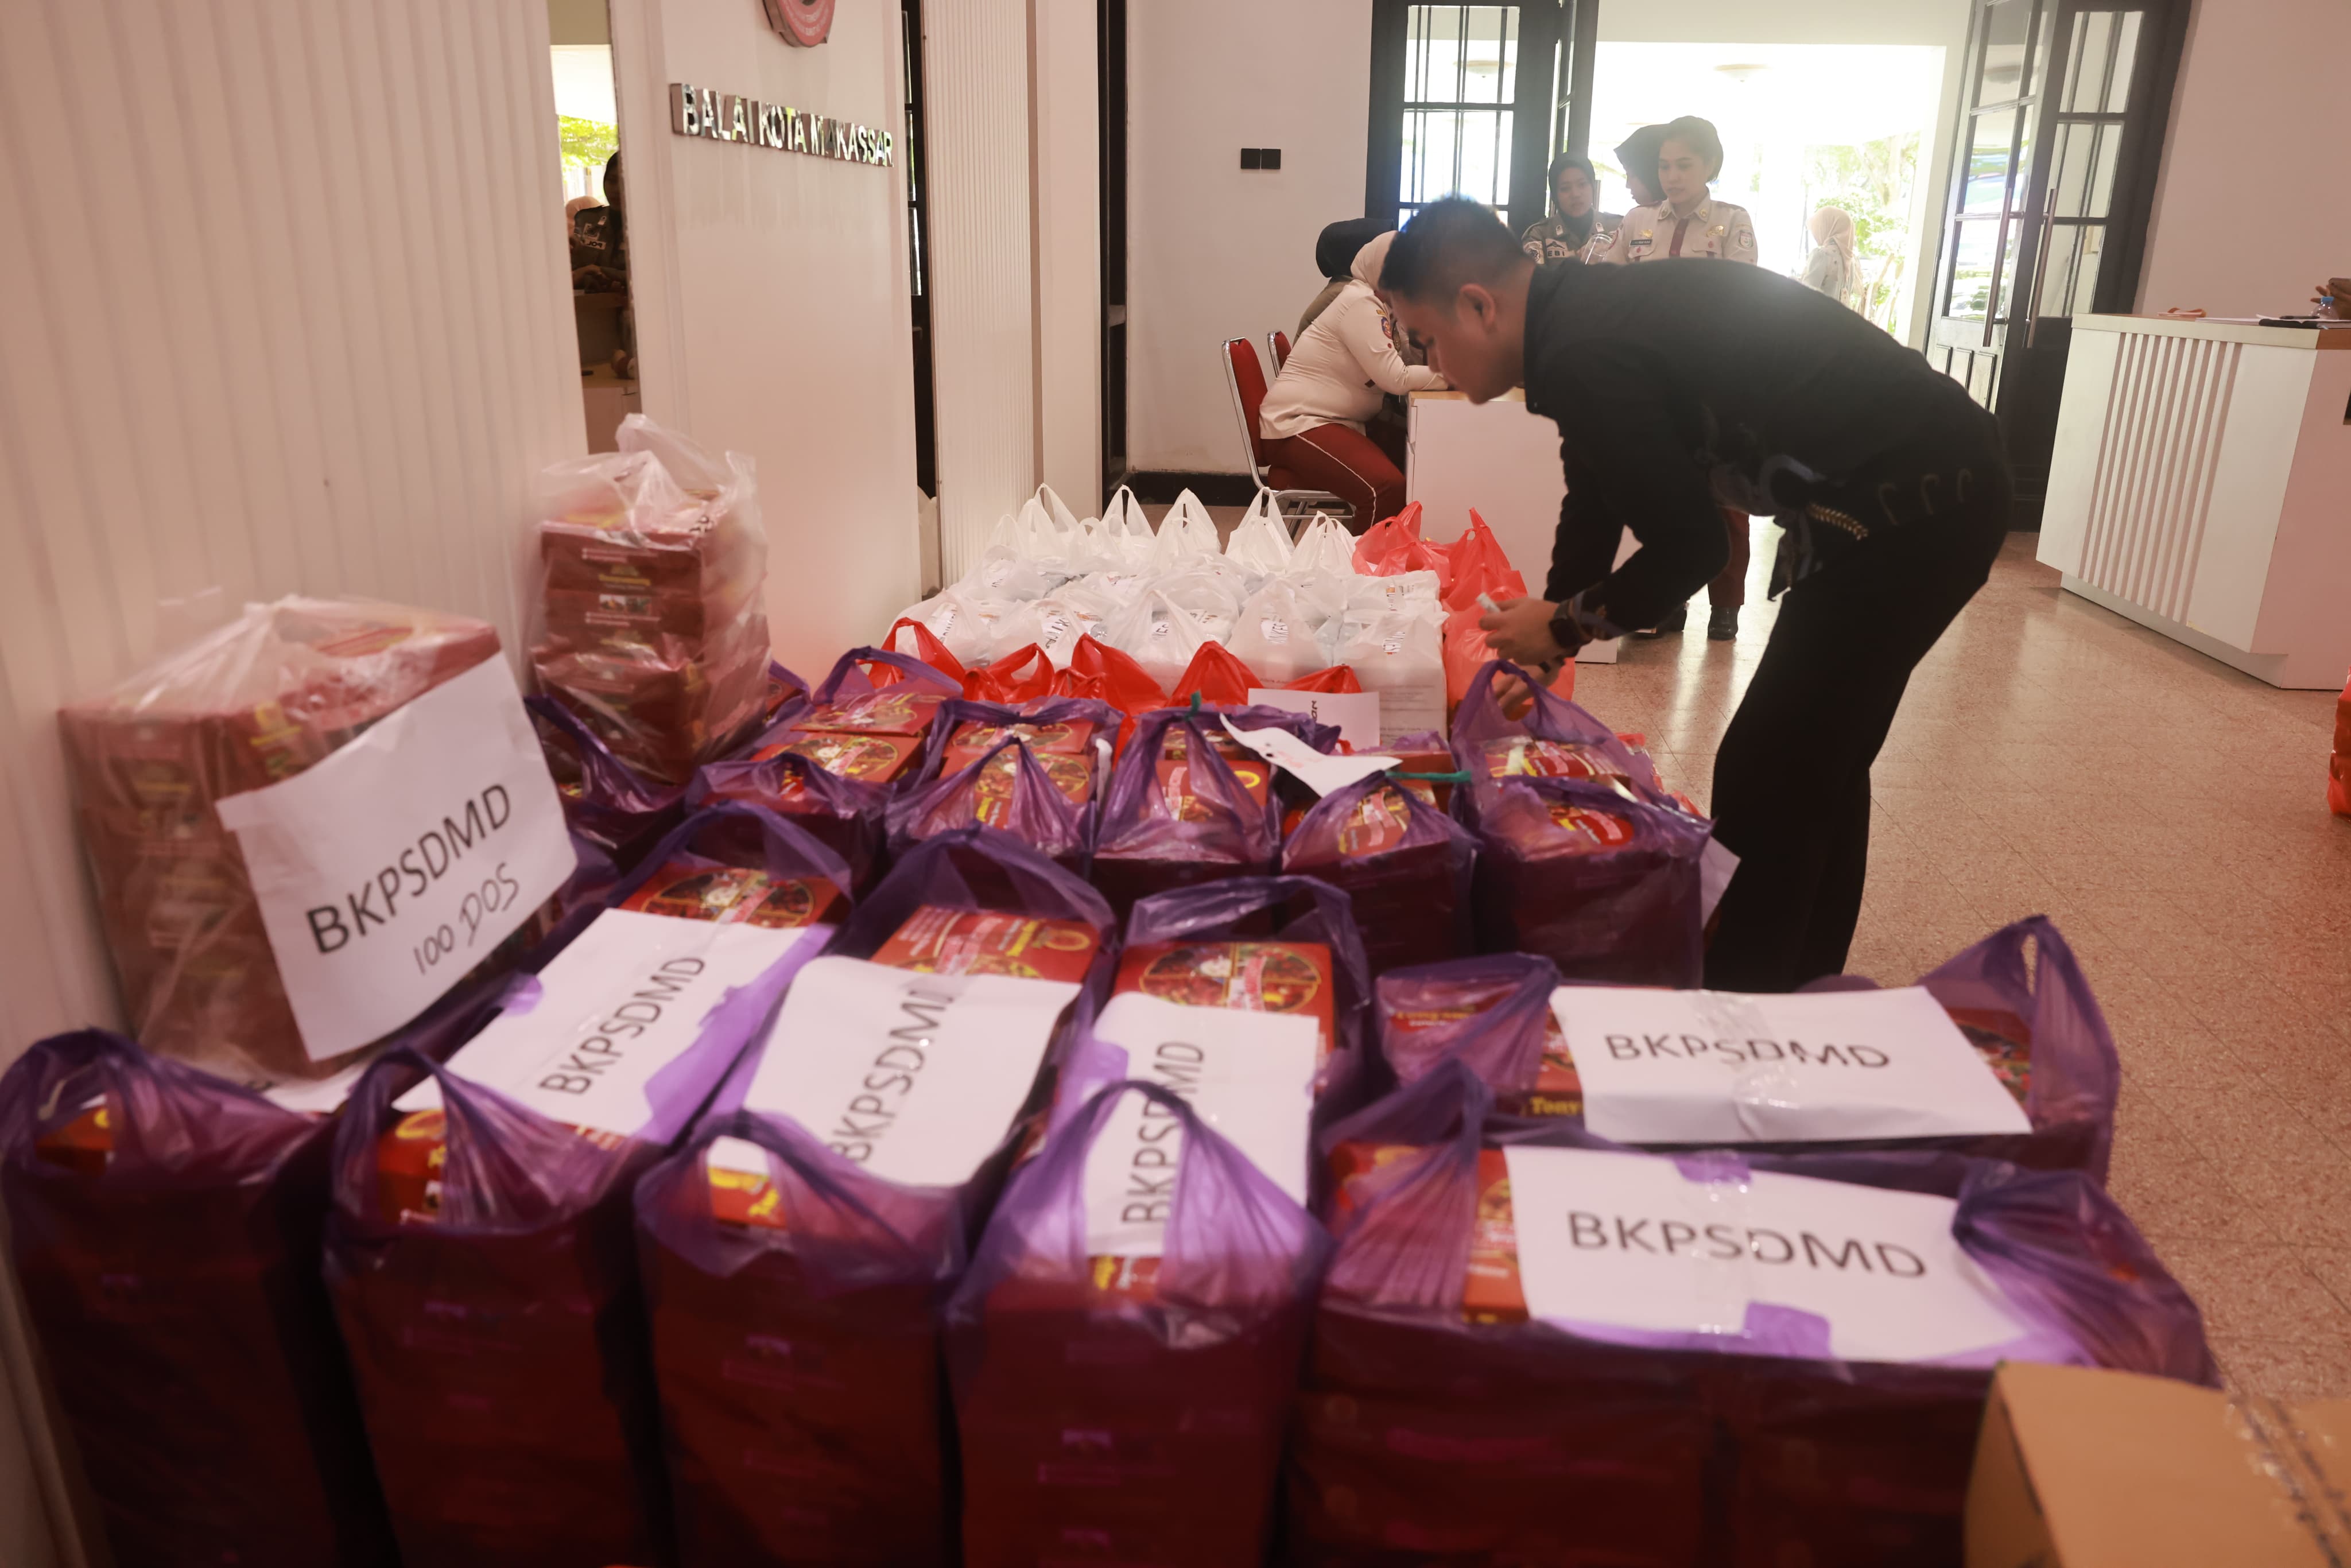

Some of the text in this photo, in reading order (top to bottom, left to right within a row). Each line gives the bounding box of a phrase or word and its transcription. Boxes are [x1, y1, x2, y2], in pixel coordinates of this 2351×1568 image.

[677, 83, 754, 145] BALAI
[758, 102, 807, 154] KOTA
[306, 783, 511, 955] BKPSDMD
[413, 861, 520, 975] 100 DOS
[538, 957, 705, 1096] BKPSDMD
[1605, 1033, 1891, 1069] BKPSDMD
[1568, 1210, 1927, 1279] BKPSDMD
